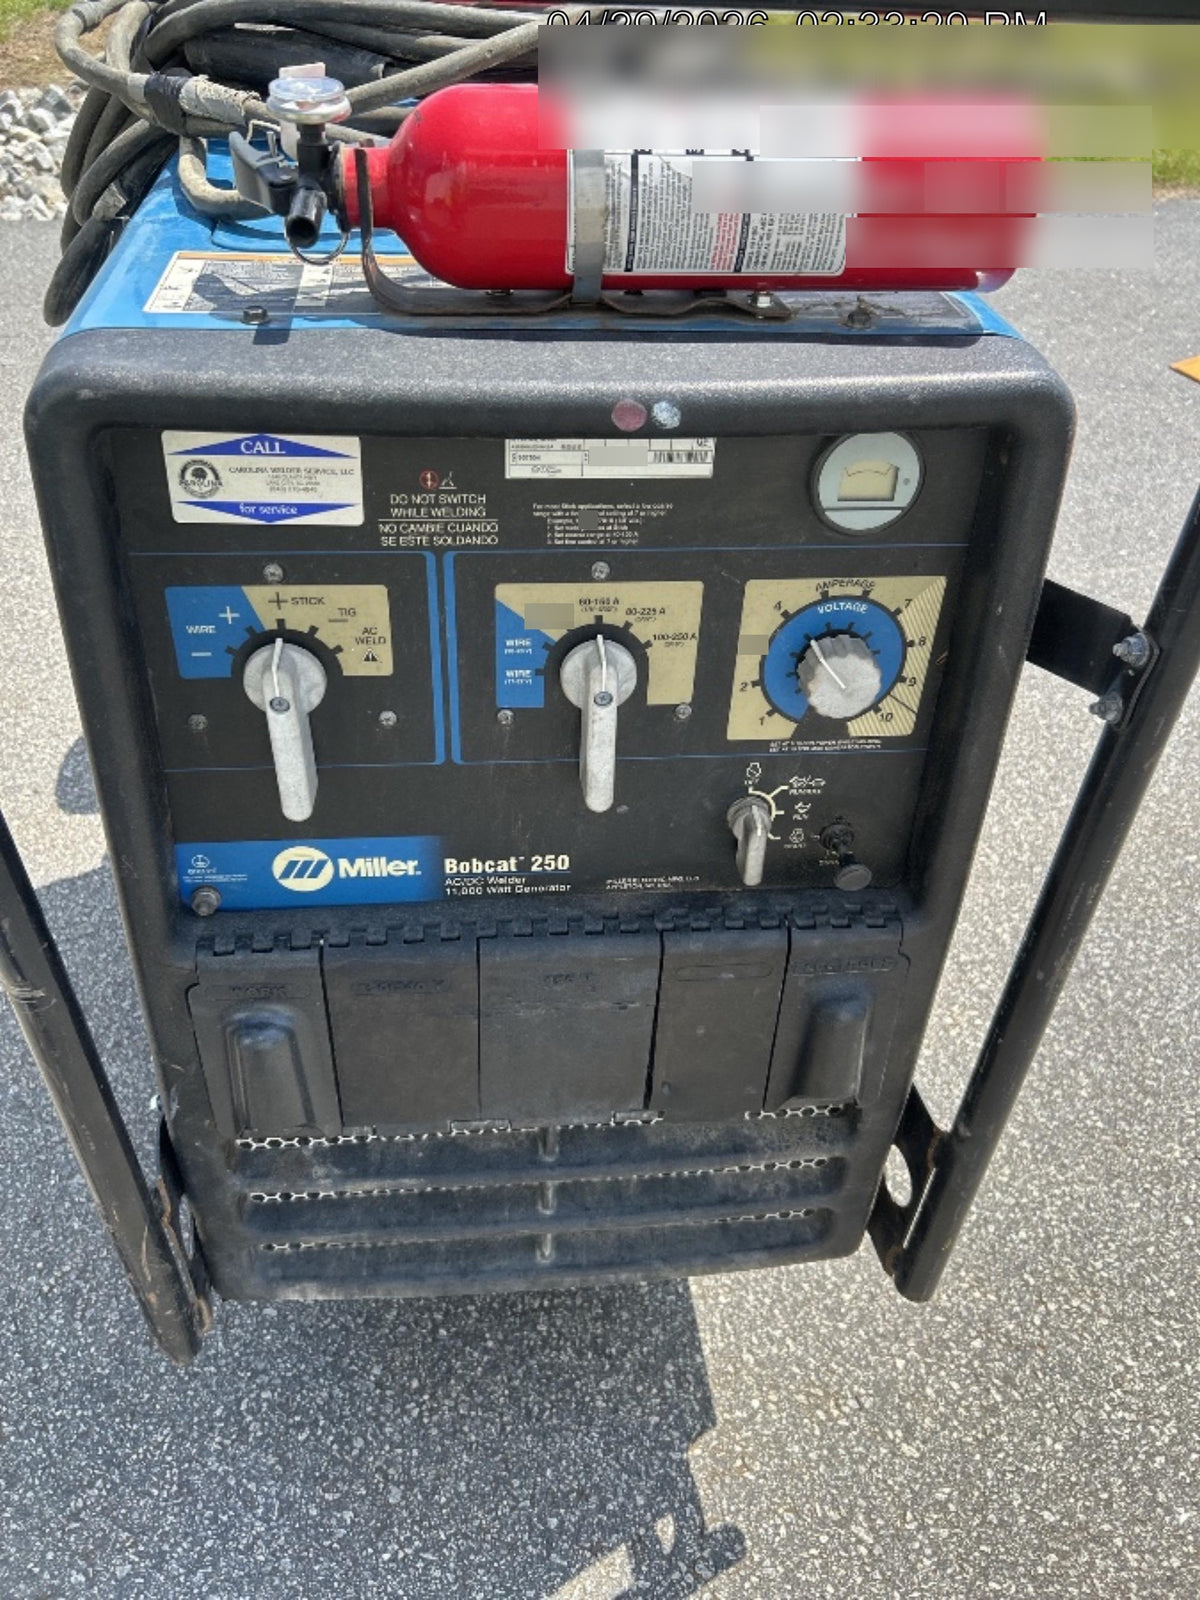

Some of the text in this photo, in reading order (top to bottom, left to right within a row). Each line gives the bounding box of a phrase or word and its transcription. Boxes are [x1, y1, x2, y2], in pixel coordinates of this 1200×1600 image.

[240, 440, 286, 454] CALL
[390, 493, 487, 505] DO NOT SWITCH
[239, 502, 298, 515] for service
[390, 506, 487, 518] WHILE WELDING
[378, 522, 499, 534] NO CAMBIE CUANDO
[381, 536, 397, 547] SE
[433, 535, 499, 546] SOLDANDO
[815, 578, 876, 592] AMPERAGE
[290, 597, 325, 606] STICK
[773, 601, 782, 611] 4
[904, 599, 913, 609] 7
[337, 608, 357, 616] TIG
[817, 601, 869, 614] VOLTAGE
[185, 625, 217, 634] WIRE
[361, 627, 378, 636] AC
[354, 637, 387, 646] WELD
[504, 638, 532, 647] WIRE
[504, 669, 532, 678] WIRE
[740, 682, 748, 691] 2
[908, 677, 917, 687] 9
[758, 716, 766, 726] 1
[879, 713, 894, 722] 10
[530, 854, 570, 872] 250
[444, 876, 526, 886] AC/DC Welder
[445, 884, 572, 897] 11,000 Watt Generator
